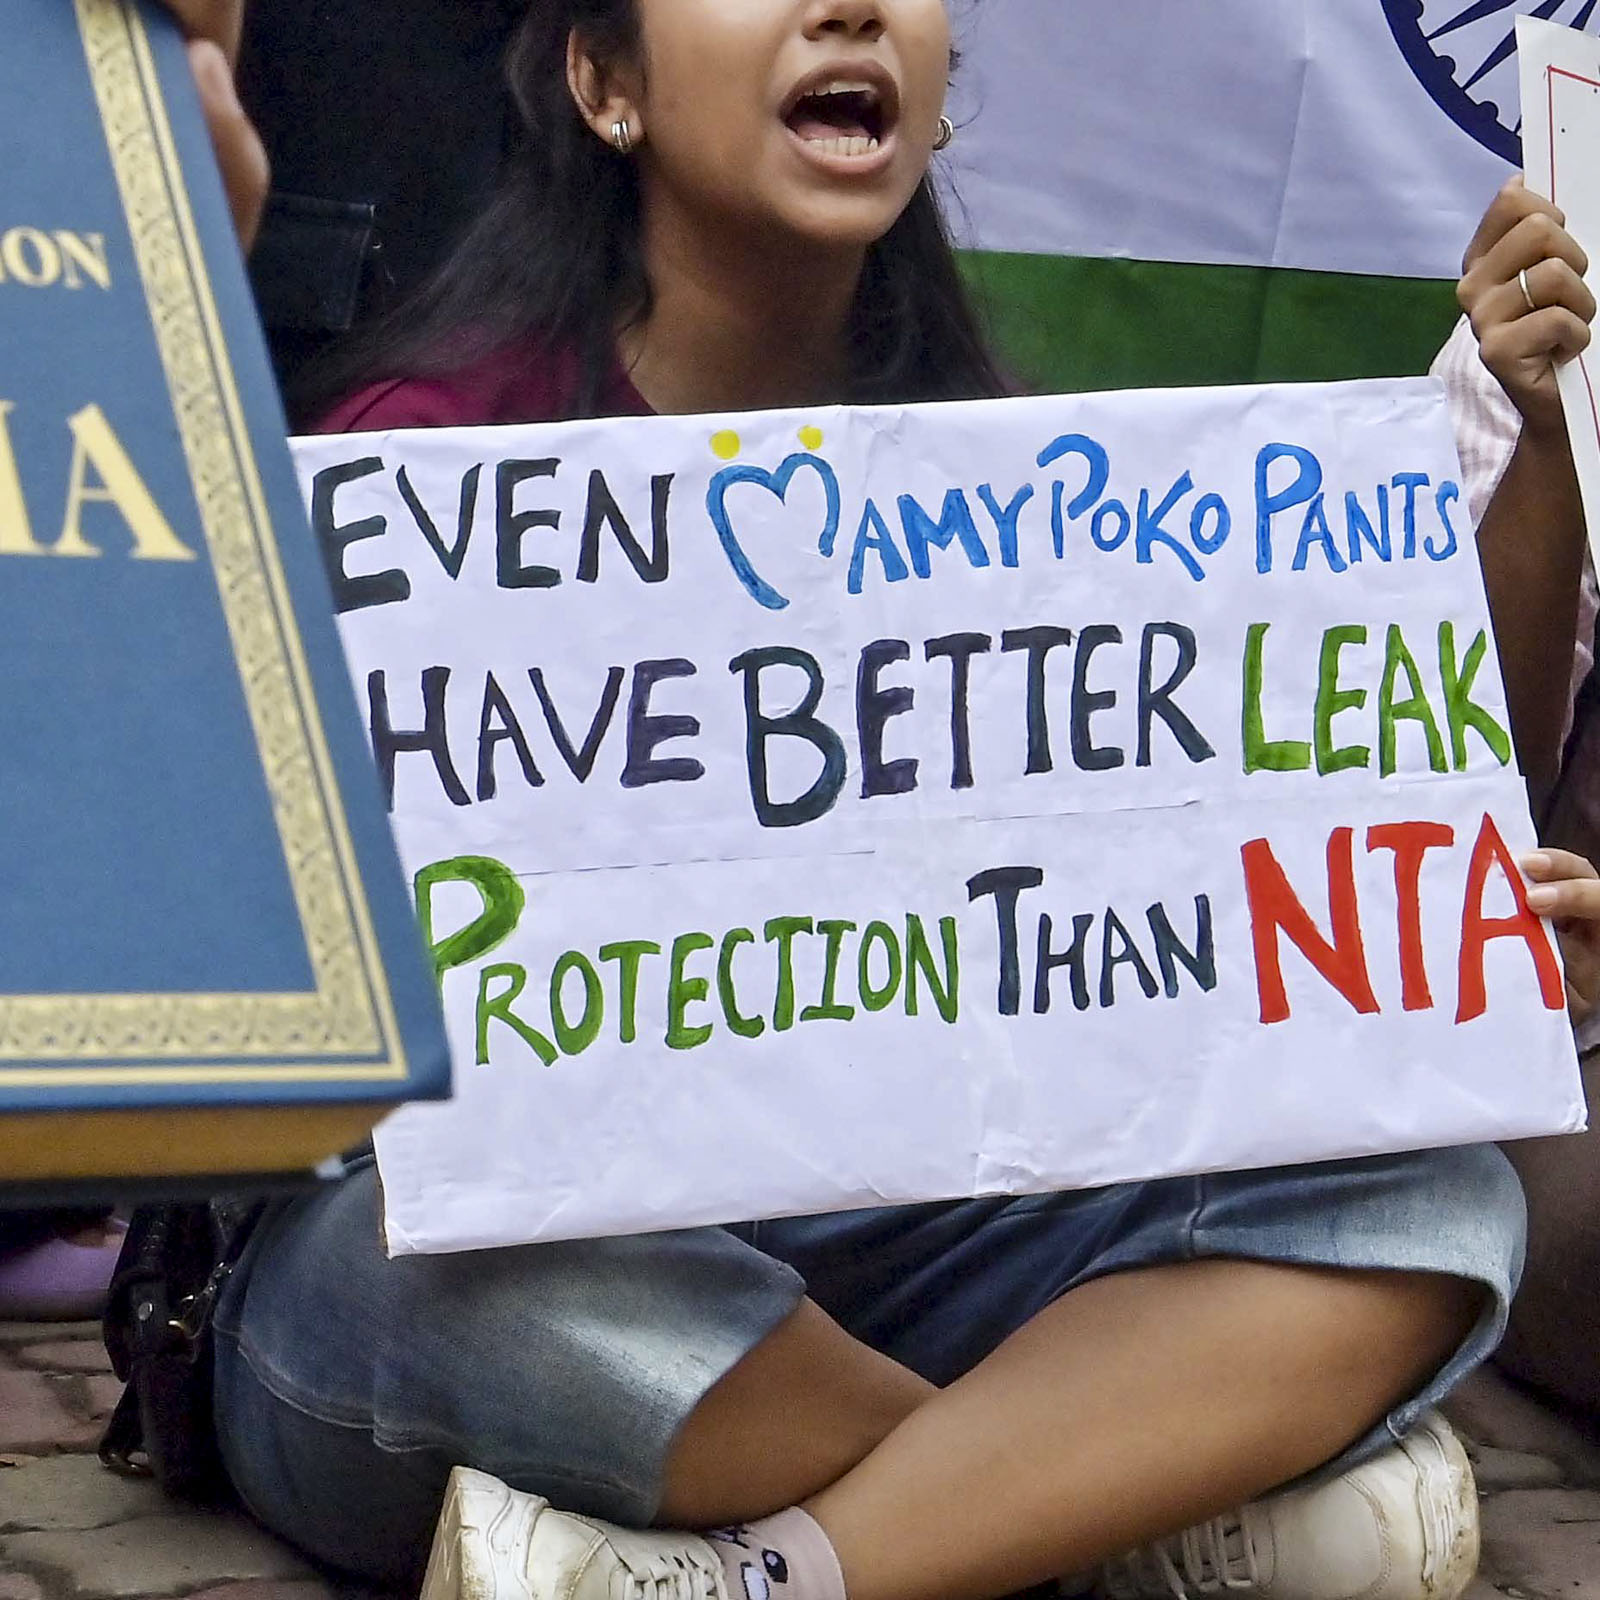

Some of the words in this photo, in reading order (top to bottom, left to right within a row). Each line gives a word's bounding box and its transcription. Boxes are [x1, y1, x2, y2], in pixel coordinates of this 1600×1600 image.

[311, 455, 676, 614] EVEN
[1255, 442, 1459, 574] PANTS
[368, 657, 706, 813] HAVE
[729, 621, 1217, 828] BETTER
[1241, 621, 1512, 778] LEAK
[413, 855, 958, 1067] PROTECTION
[965, 866, 1218, 1016] THAN
[1240, 812, 1565, 1025] NTA
